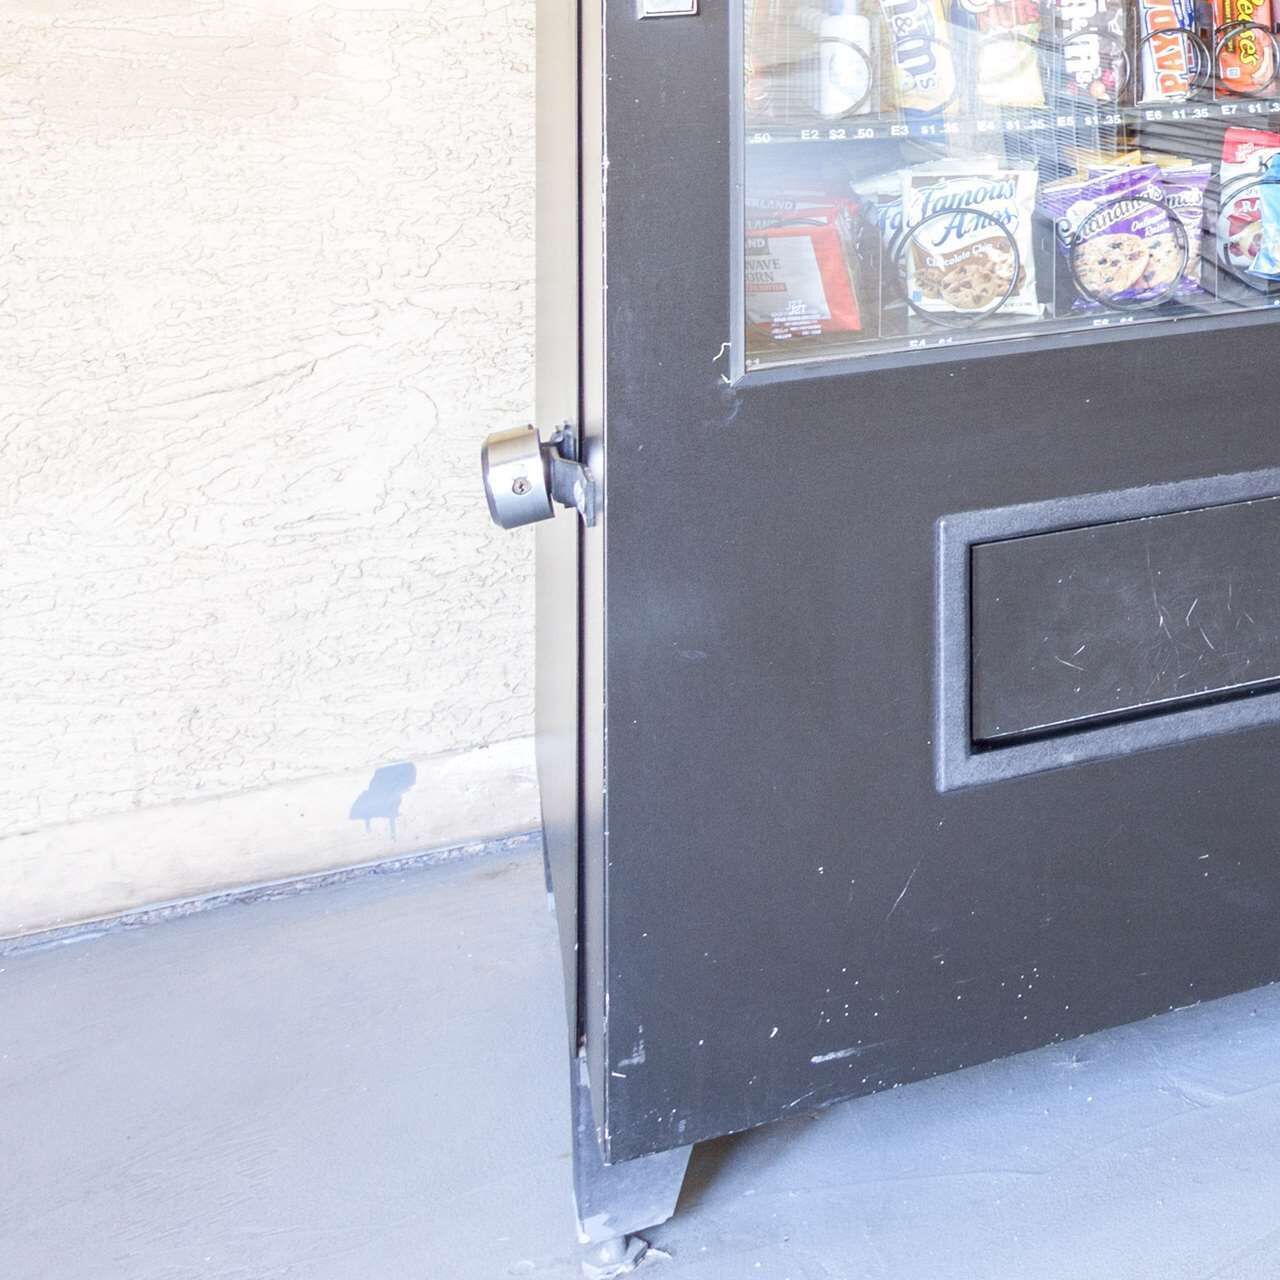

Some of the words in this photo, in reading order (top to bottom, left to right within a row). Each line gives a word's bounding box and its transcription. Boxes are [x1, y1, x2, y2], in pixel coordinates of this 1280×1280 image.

[1221, 104, 1237, 115] E7
[1146, 110, 1162, 121] E6
[801, 129, 819, 140] E2
[891, 125, 909, 136] E3
[917, 181, 1015, 221] Famous
